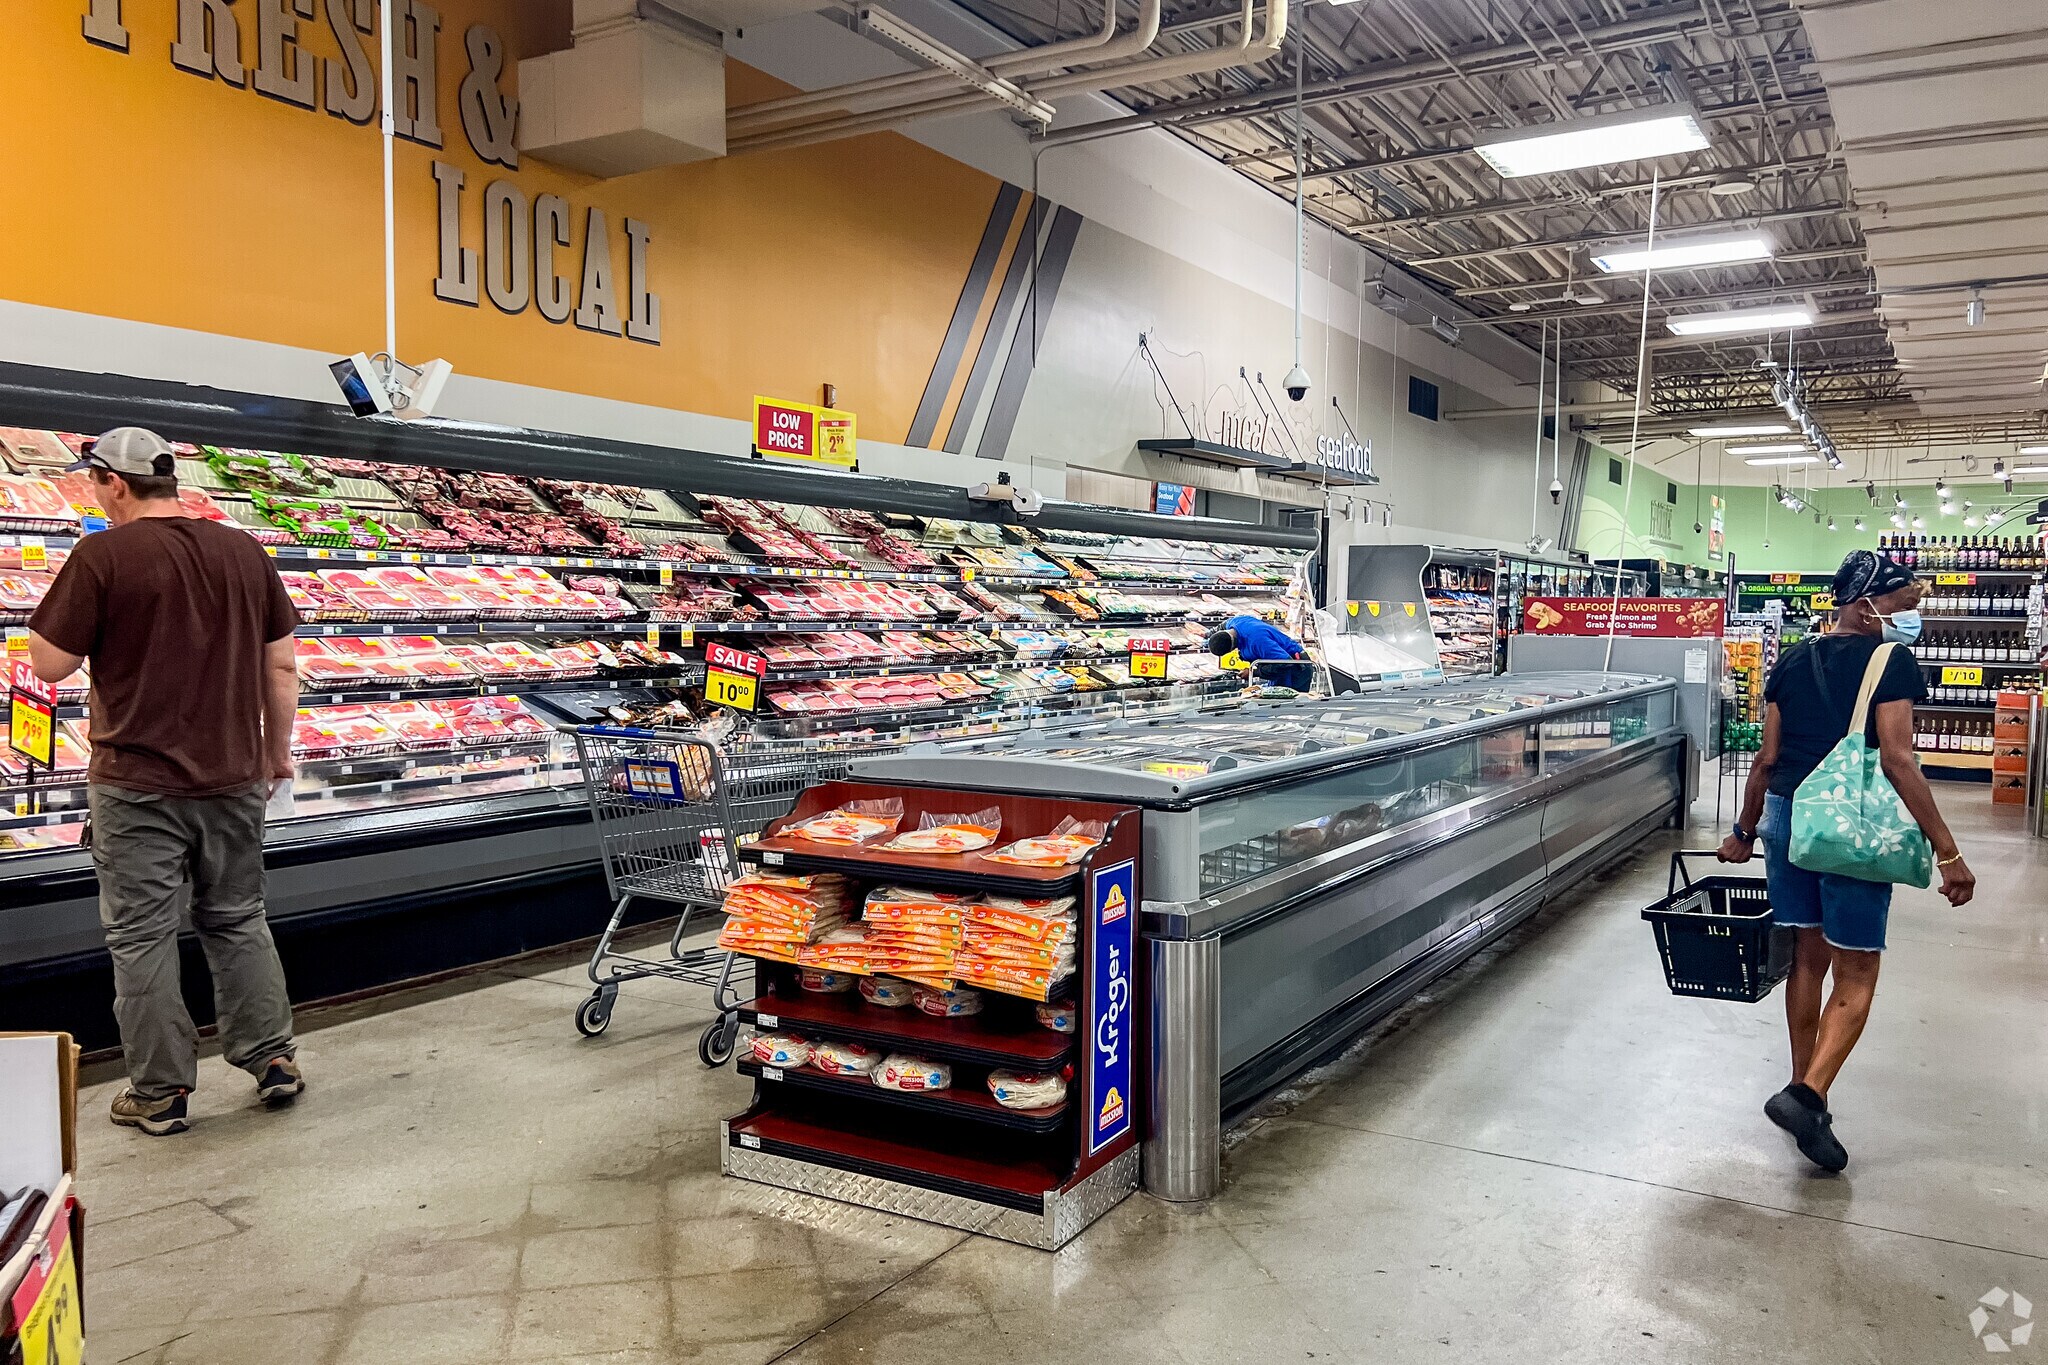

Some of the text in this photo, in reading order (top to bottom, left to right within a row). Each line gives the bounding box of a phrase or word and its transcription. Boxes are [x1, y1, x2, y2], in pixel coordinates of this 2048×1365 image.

[459, 24, 519, 171] &
[432, 160, 661, 346] LOCAL
[772, 411, 801, 431] LOW
[767, 429, 805, 450] PRICE
[1316, 431, 1372, 476] seafood
[1748, 585, 1776, 593] ORGANIC
[1794, 585, 1822, 593] ORGANIC
[1563, 602, 1682, 613] SEAFOOD FAVORITES
[1585, 613, 1608, 621] Fresh
[1585, 621, 1605, 629] Grab
[1628, 622, 1657, 631] Shrimp
[1133, 640, 1164, 650] SALE
[713, 646, 759, 673] SALE
[15, 664, 52, 700] SALE
[922, 908, 945, 916] Tortillas
[991, 912, 1027, 927] Flour Tortillas
[1103, 903, 1126, 922] MISSION
[773, 926, 794, 934] Tortillas
[991, 965, 1006, 974] Flour
[1097, 943, 1128, 1069] Kroger
[901, 1076, 925, 1084] MISSION
[1101, 1106, 1123, 1127] MISSION
